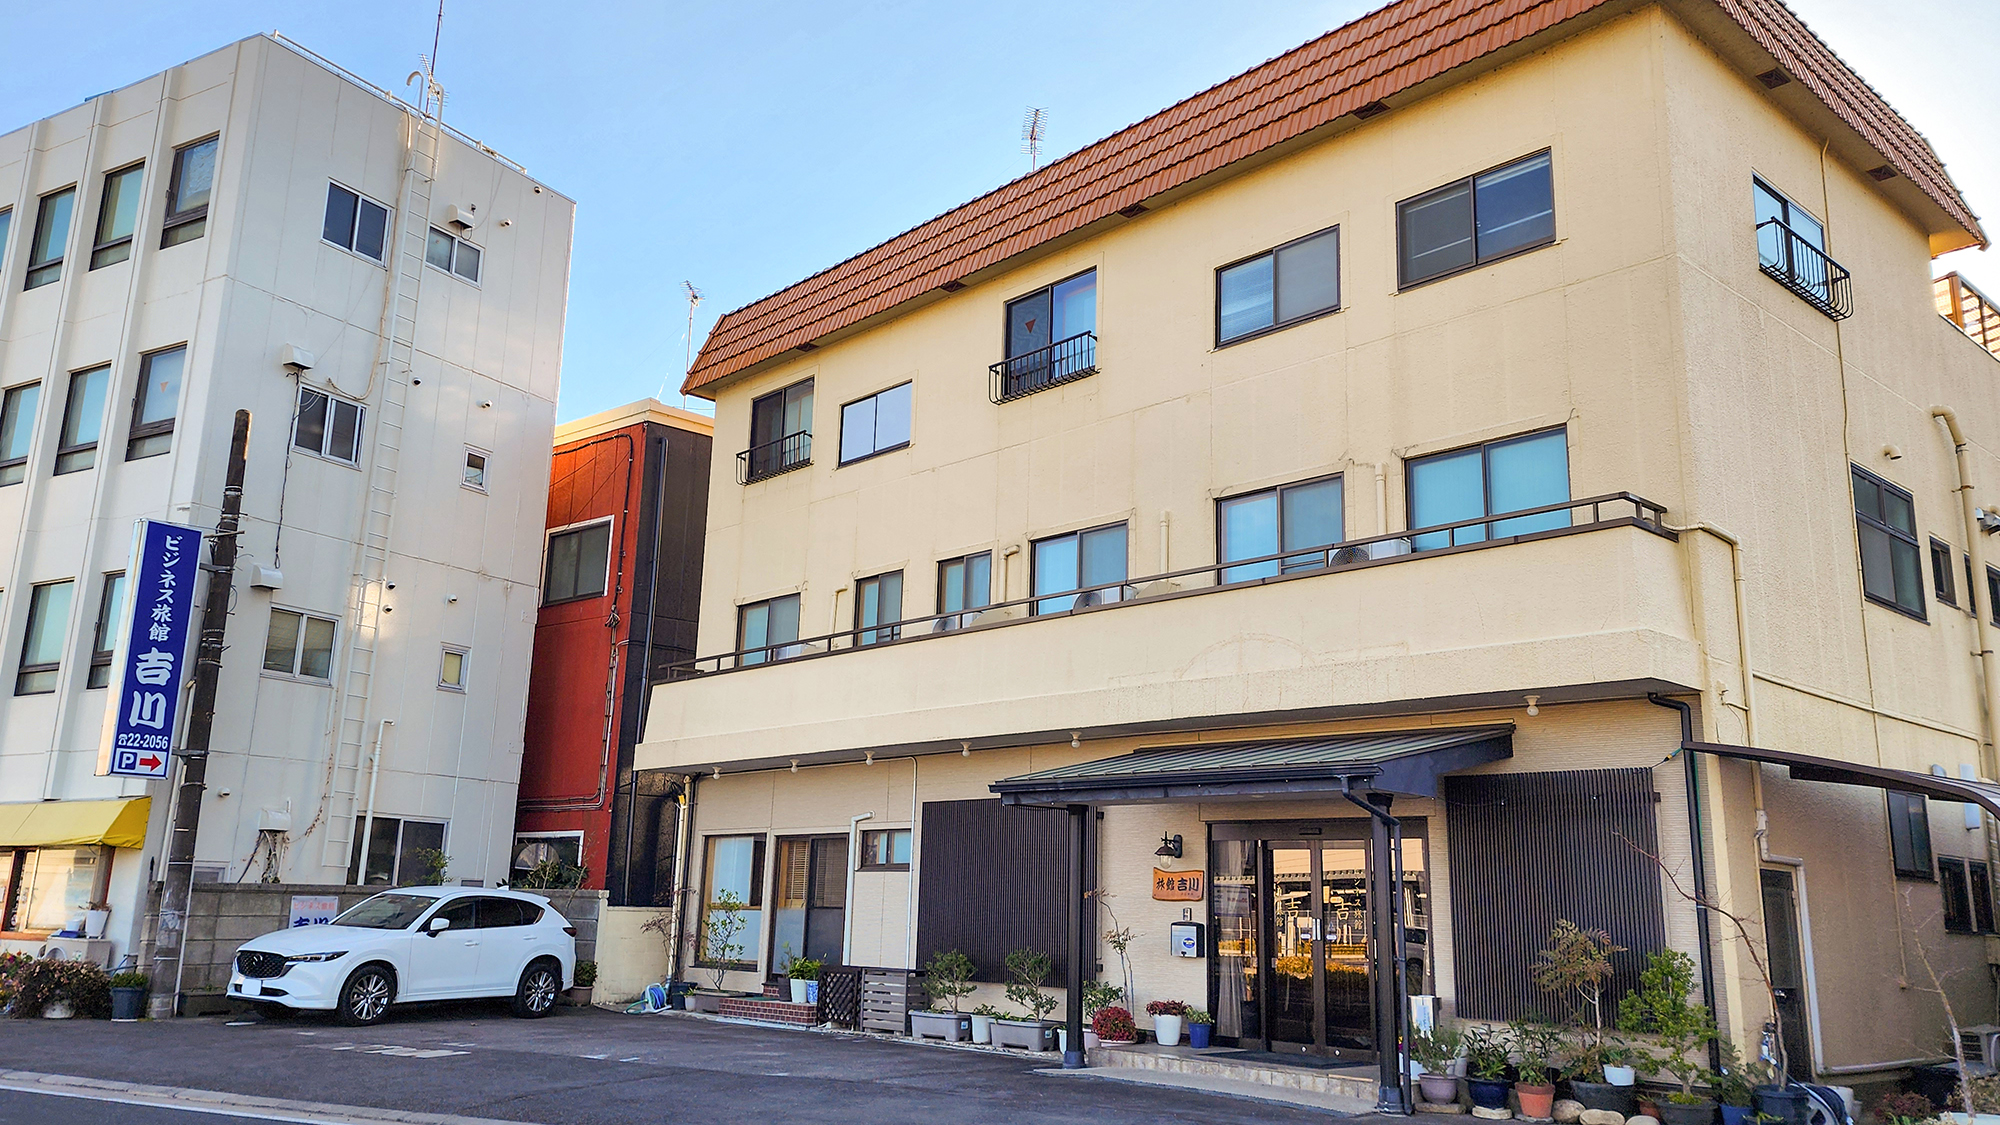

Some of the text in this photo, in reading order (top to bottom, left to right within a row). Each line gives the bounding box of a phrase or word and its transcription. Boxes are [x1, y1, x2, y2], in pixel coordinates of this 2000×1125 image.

[148, 535, 183, 642] ビジネス旅館
[129, 647, 174, 729] 吉川
[122, 753, 134, 768] P
[127, 733, 169, 749] 22-2056
